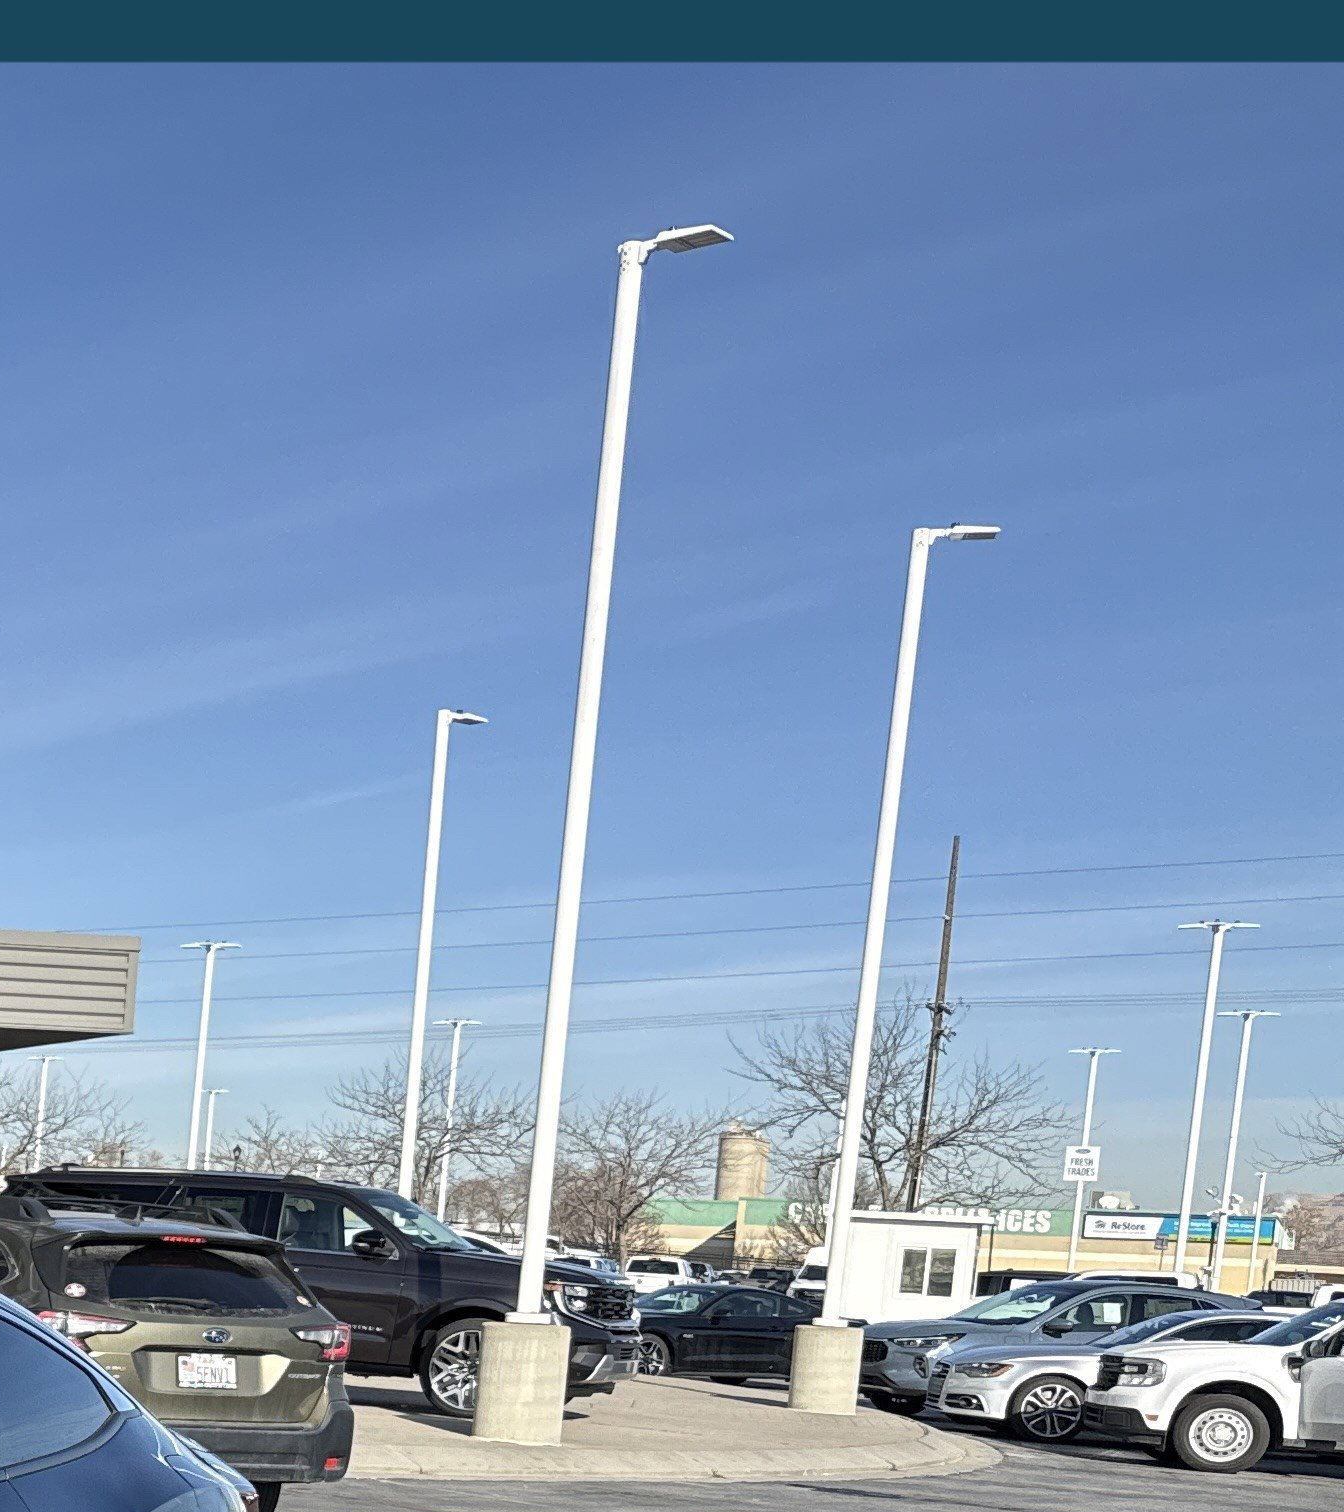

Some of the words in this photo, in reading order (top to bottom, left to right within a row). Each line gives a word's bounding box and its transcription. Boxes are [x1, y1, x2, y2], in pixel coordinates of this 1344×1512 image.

[1070, 1157, 1094, 1166] FRESH
[1067, 1167, 1096, 1177] TRADES
[1111, 1221, 1146, 1231] ReStore
